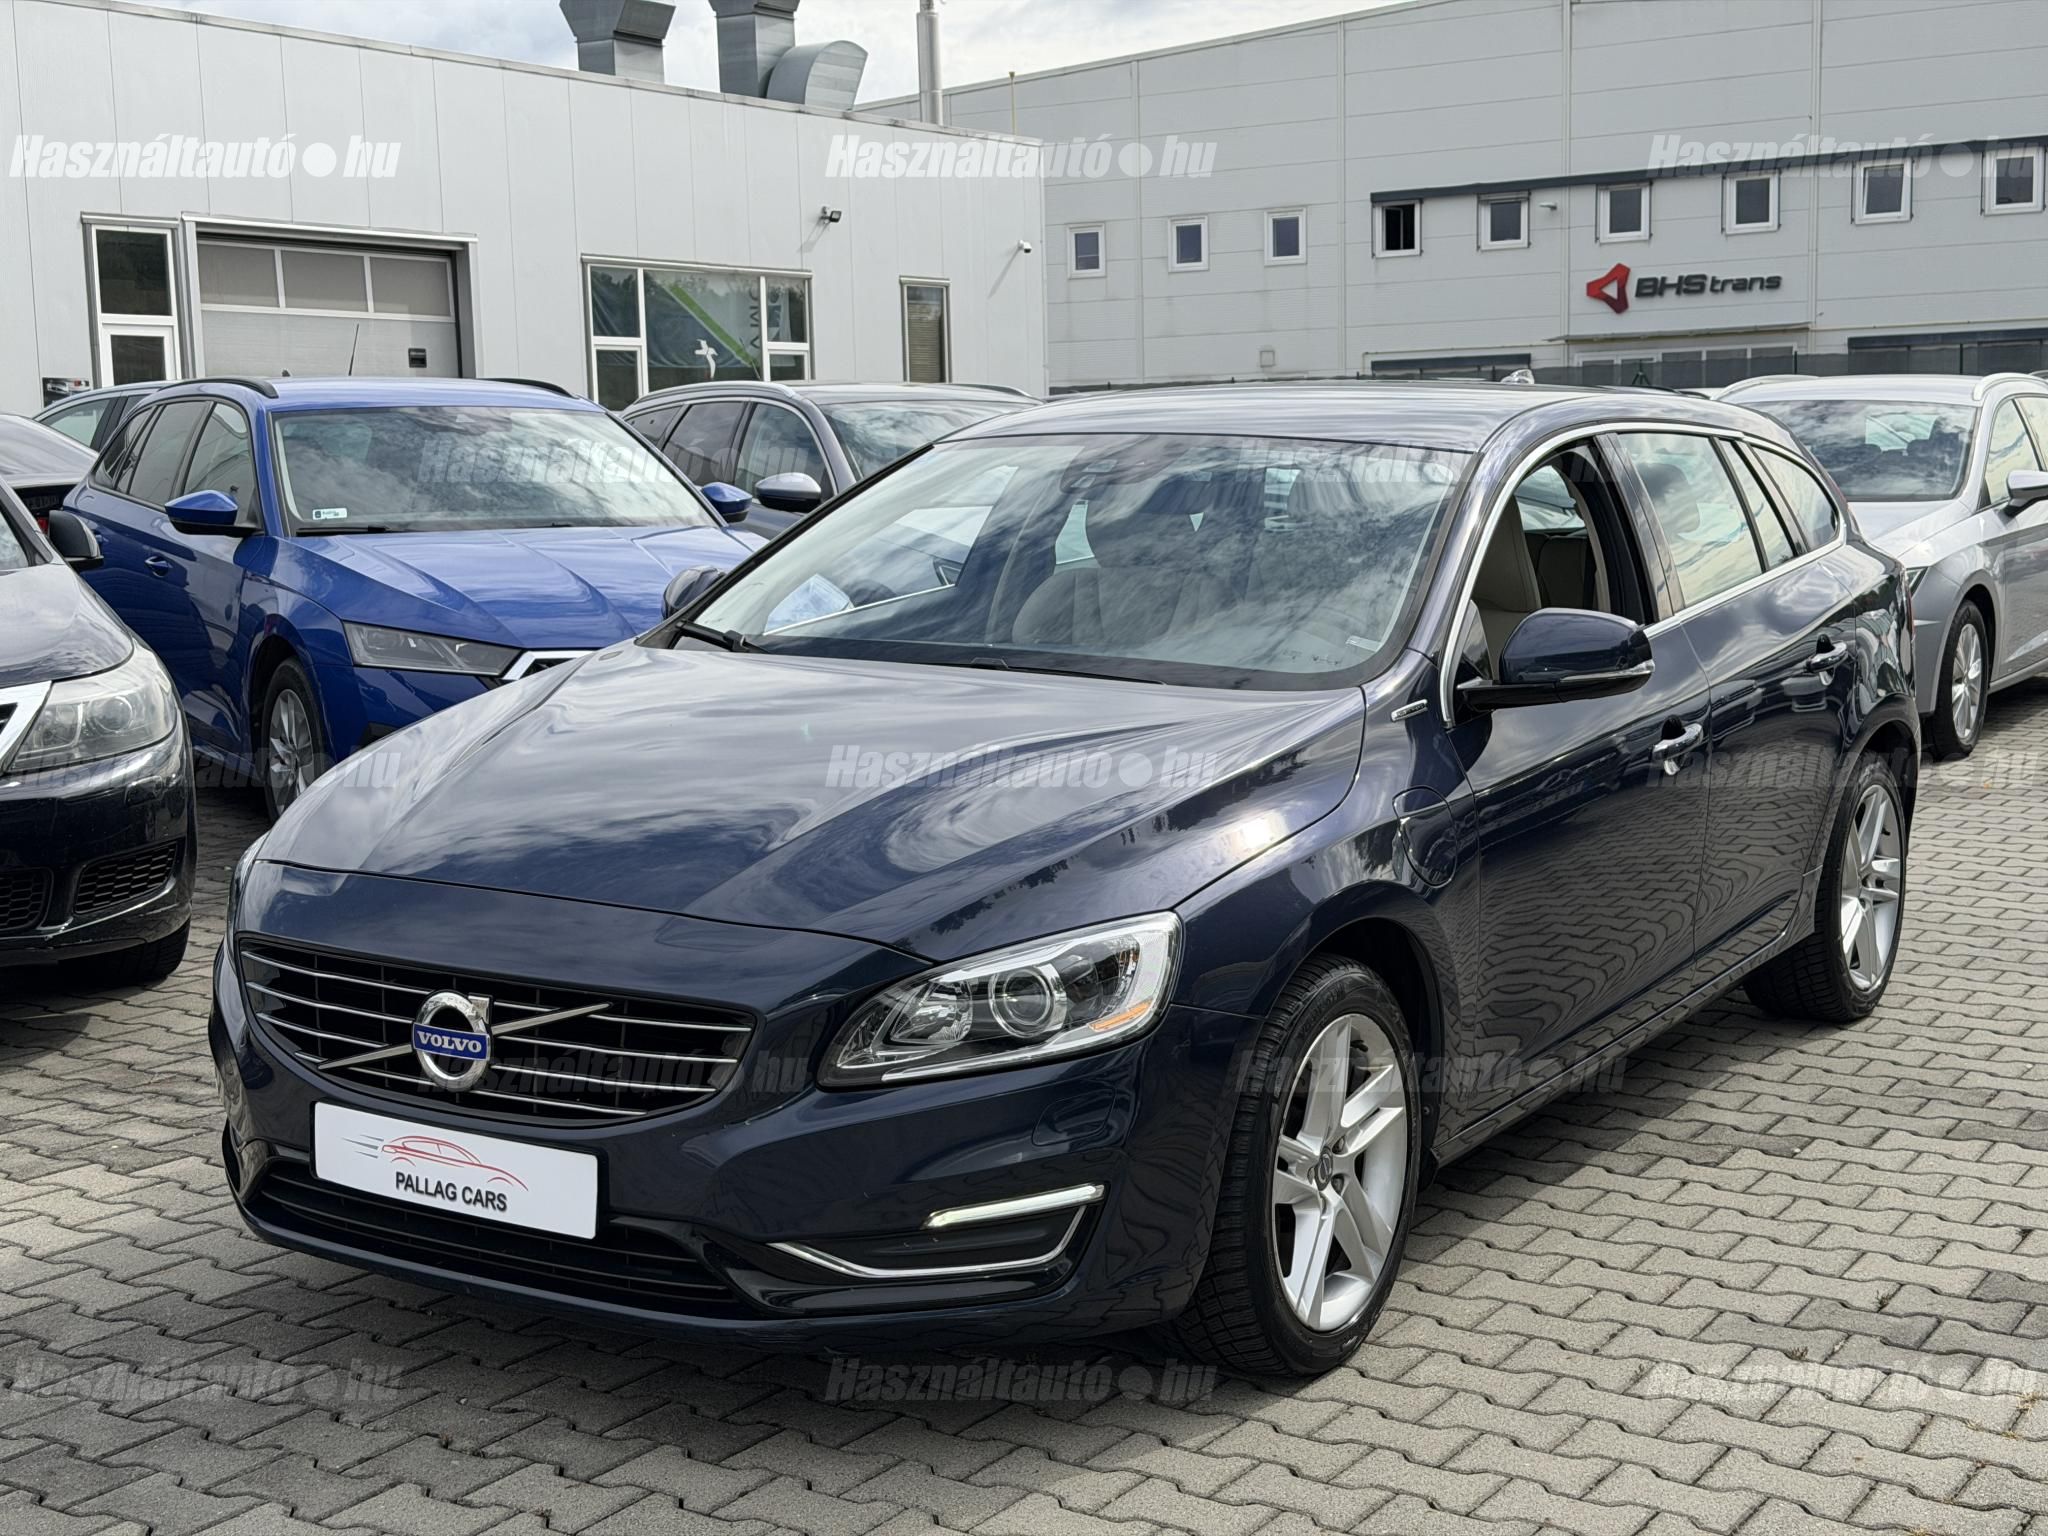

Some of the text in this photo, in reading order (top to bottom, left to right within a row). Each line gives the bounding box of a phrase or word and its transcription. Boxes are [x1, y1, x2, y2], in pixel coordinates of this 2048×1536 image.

[1635, 274, 1782, 298] BHS trans
[417, 1031, 482, 1053] VOLVO
[396, 1171, 507, 1212] PALLAG CARS
